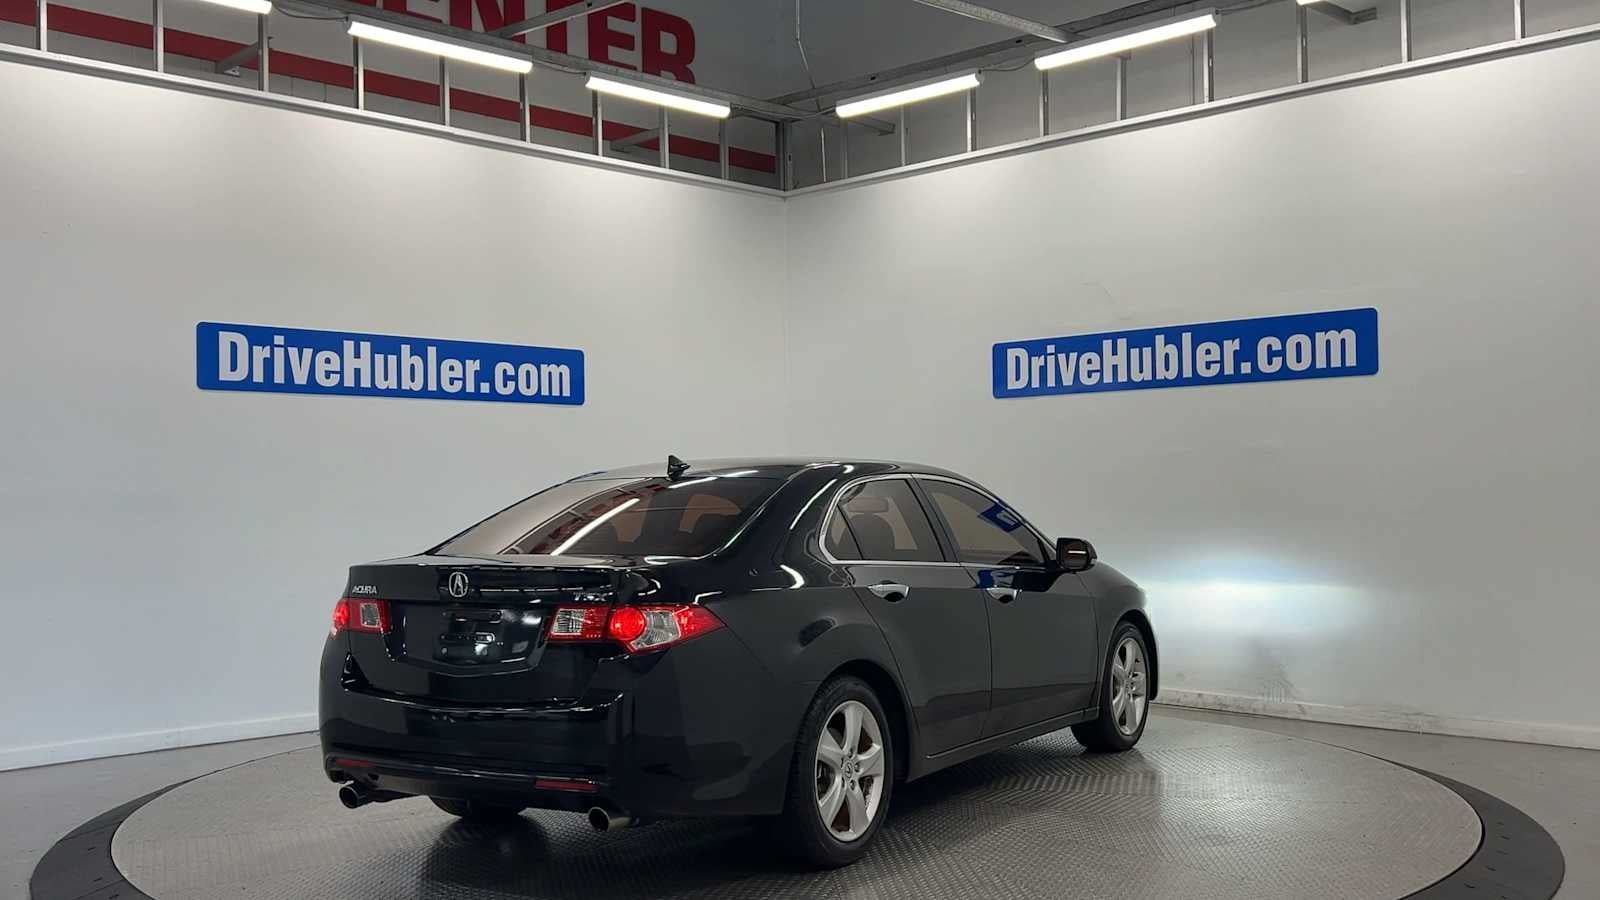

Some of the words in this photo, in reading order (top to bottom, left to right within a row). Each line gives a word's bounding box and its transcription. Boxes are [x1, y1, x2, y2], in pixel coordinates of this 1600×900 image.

[346, 0, 696, 85] NTER
[218, 331, 571, 397] DriveHubler.com
[1006, 328, 1357, 390] DriveHubler.com
[352, 585, 378, 595] ACURA
